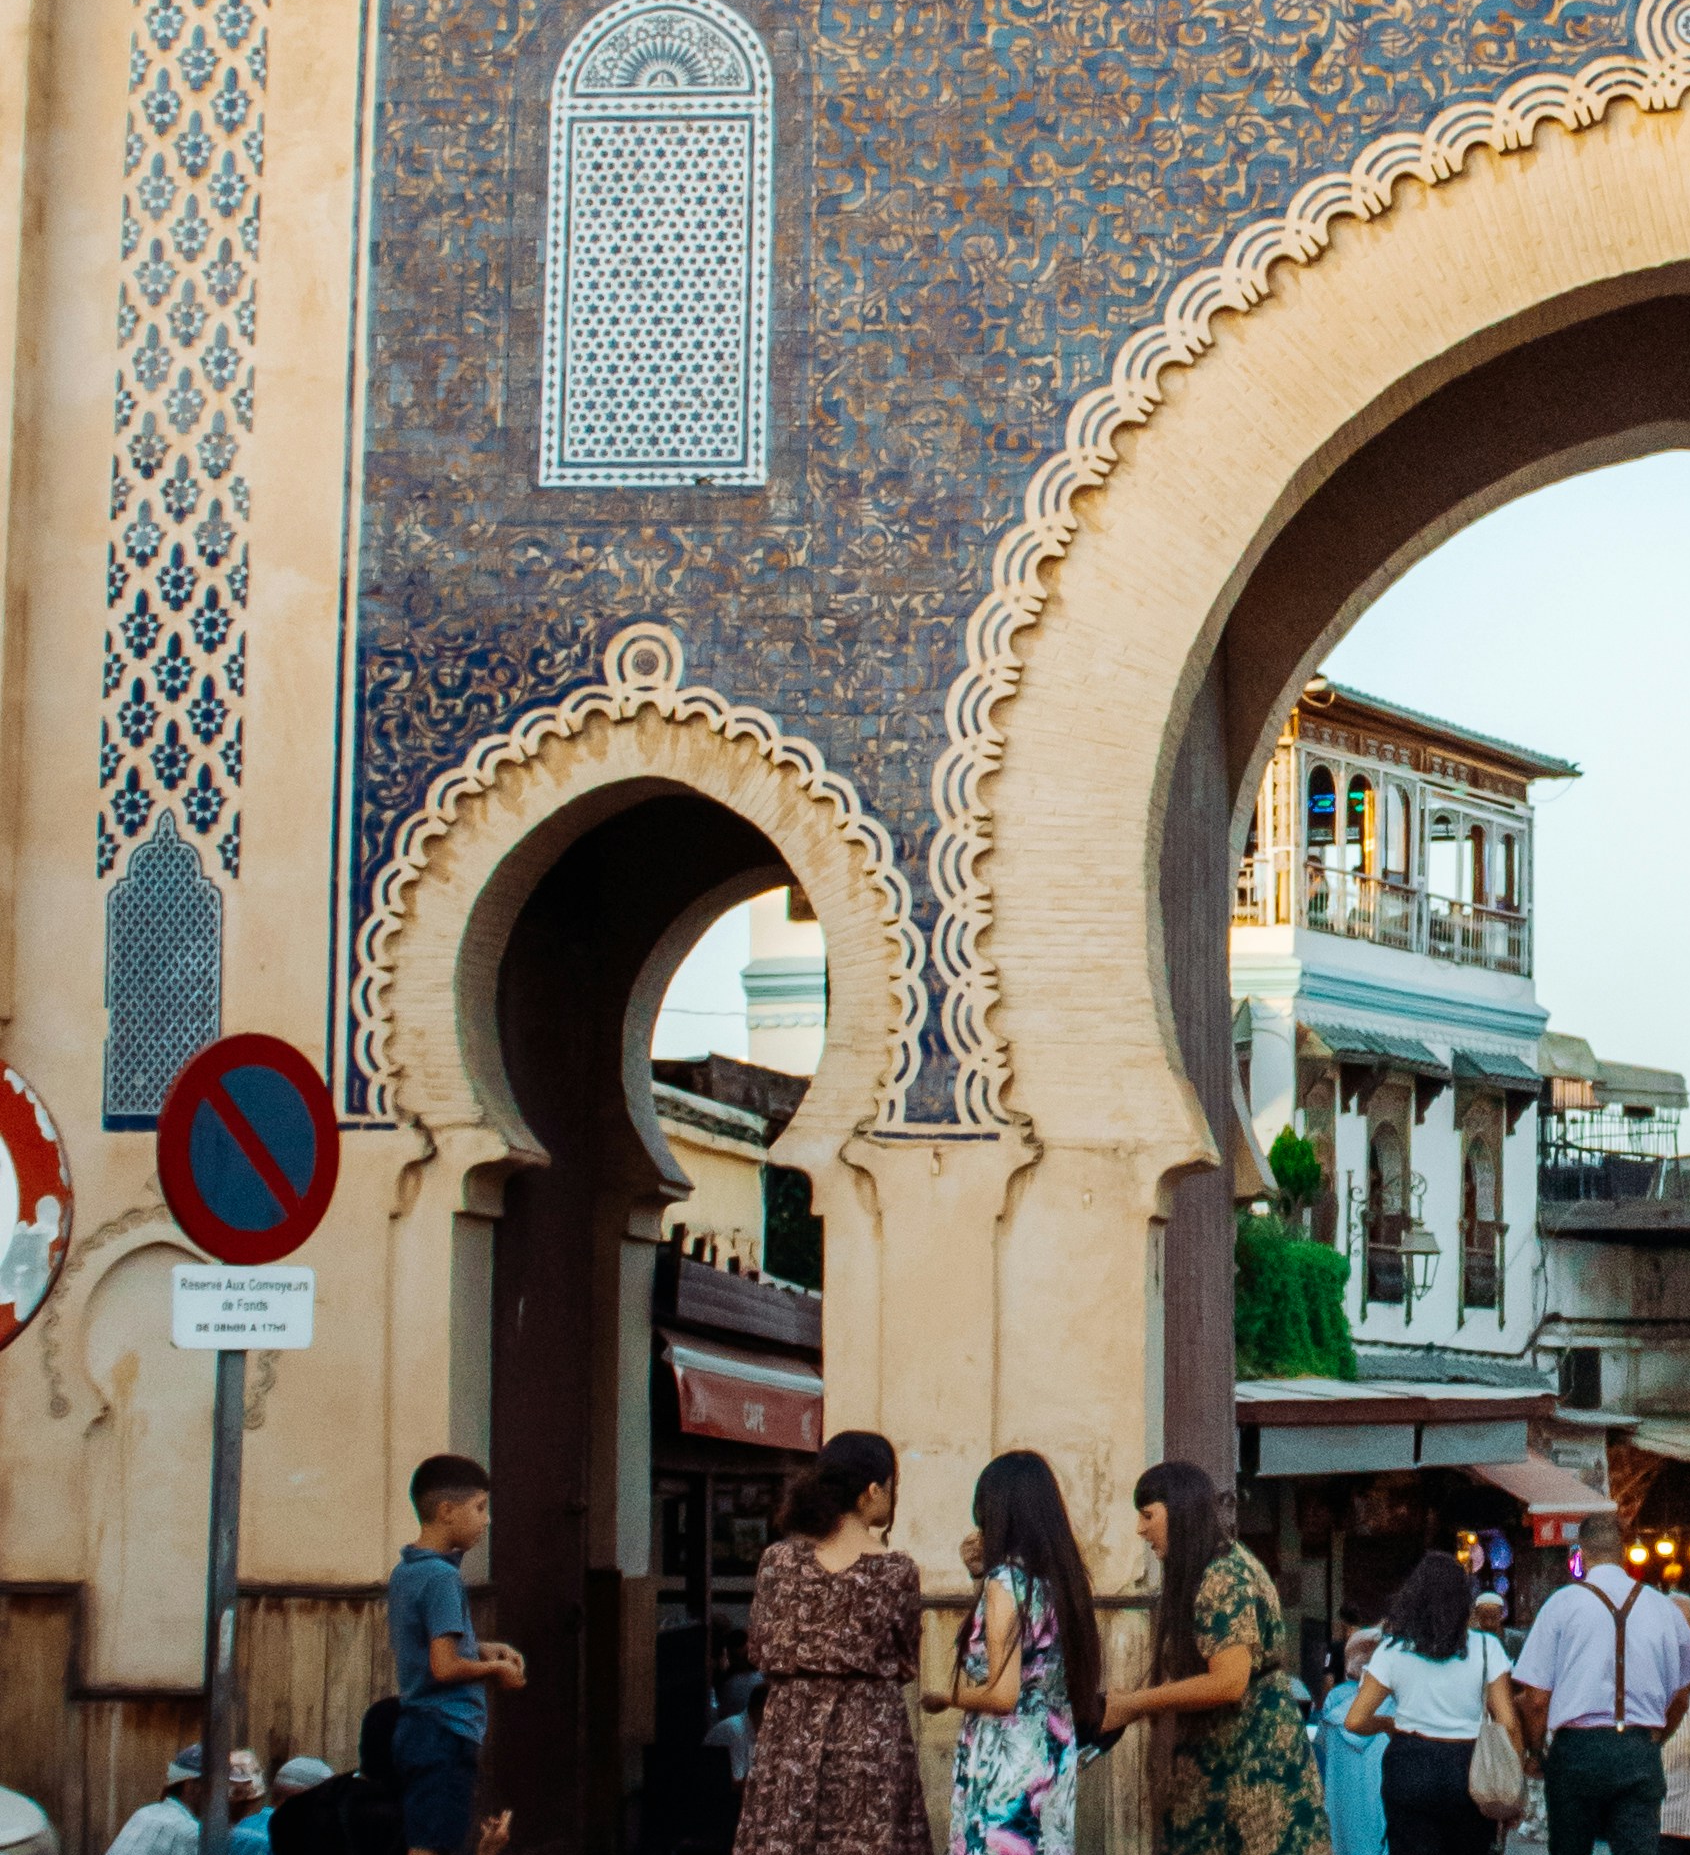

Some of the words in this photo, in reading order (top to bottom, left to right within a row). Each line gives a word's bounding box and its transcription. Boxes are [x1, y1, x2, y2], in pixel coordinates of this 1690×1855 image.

[225, 1279, 245, 1291] Aux
[221, 1300, 234, 1311] de
[237, 1298, 268, 1311] Fonds
